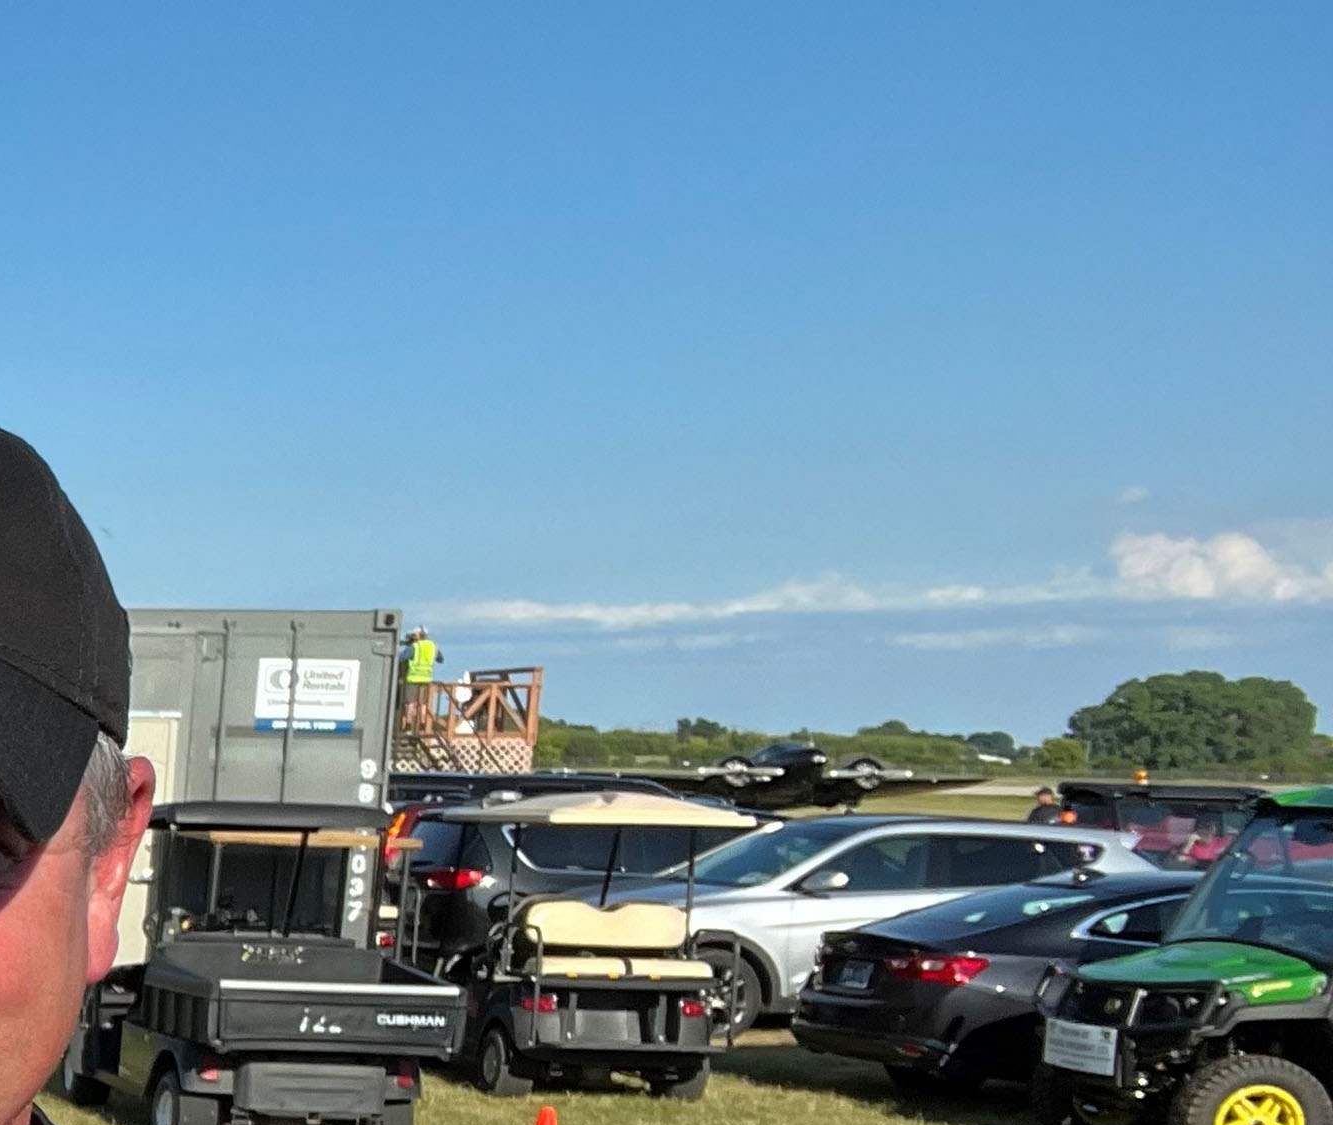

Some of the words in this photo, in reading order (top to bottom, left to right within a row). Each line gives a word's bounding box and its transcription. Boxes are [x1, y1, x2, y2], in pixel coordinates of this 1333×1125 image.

[303, 669, 345, 681] United
[302, 680, 347, 692] Rentals
[377, 1013, 446, 1028] CUSHMAN
